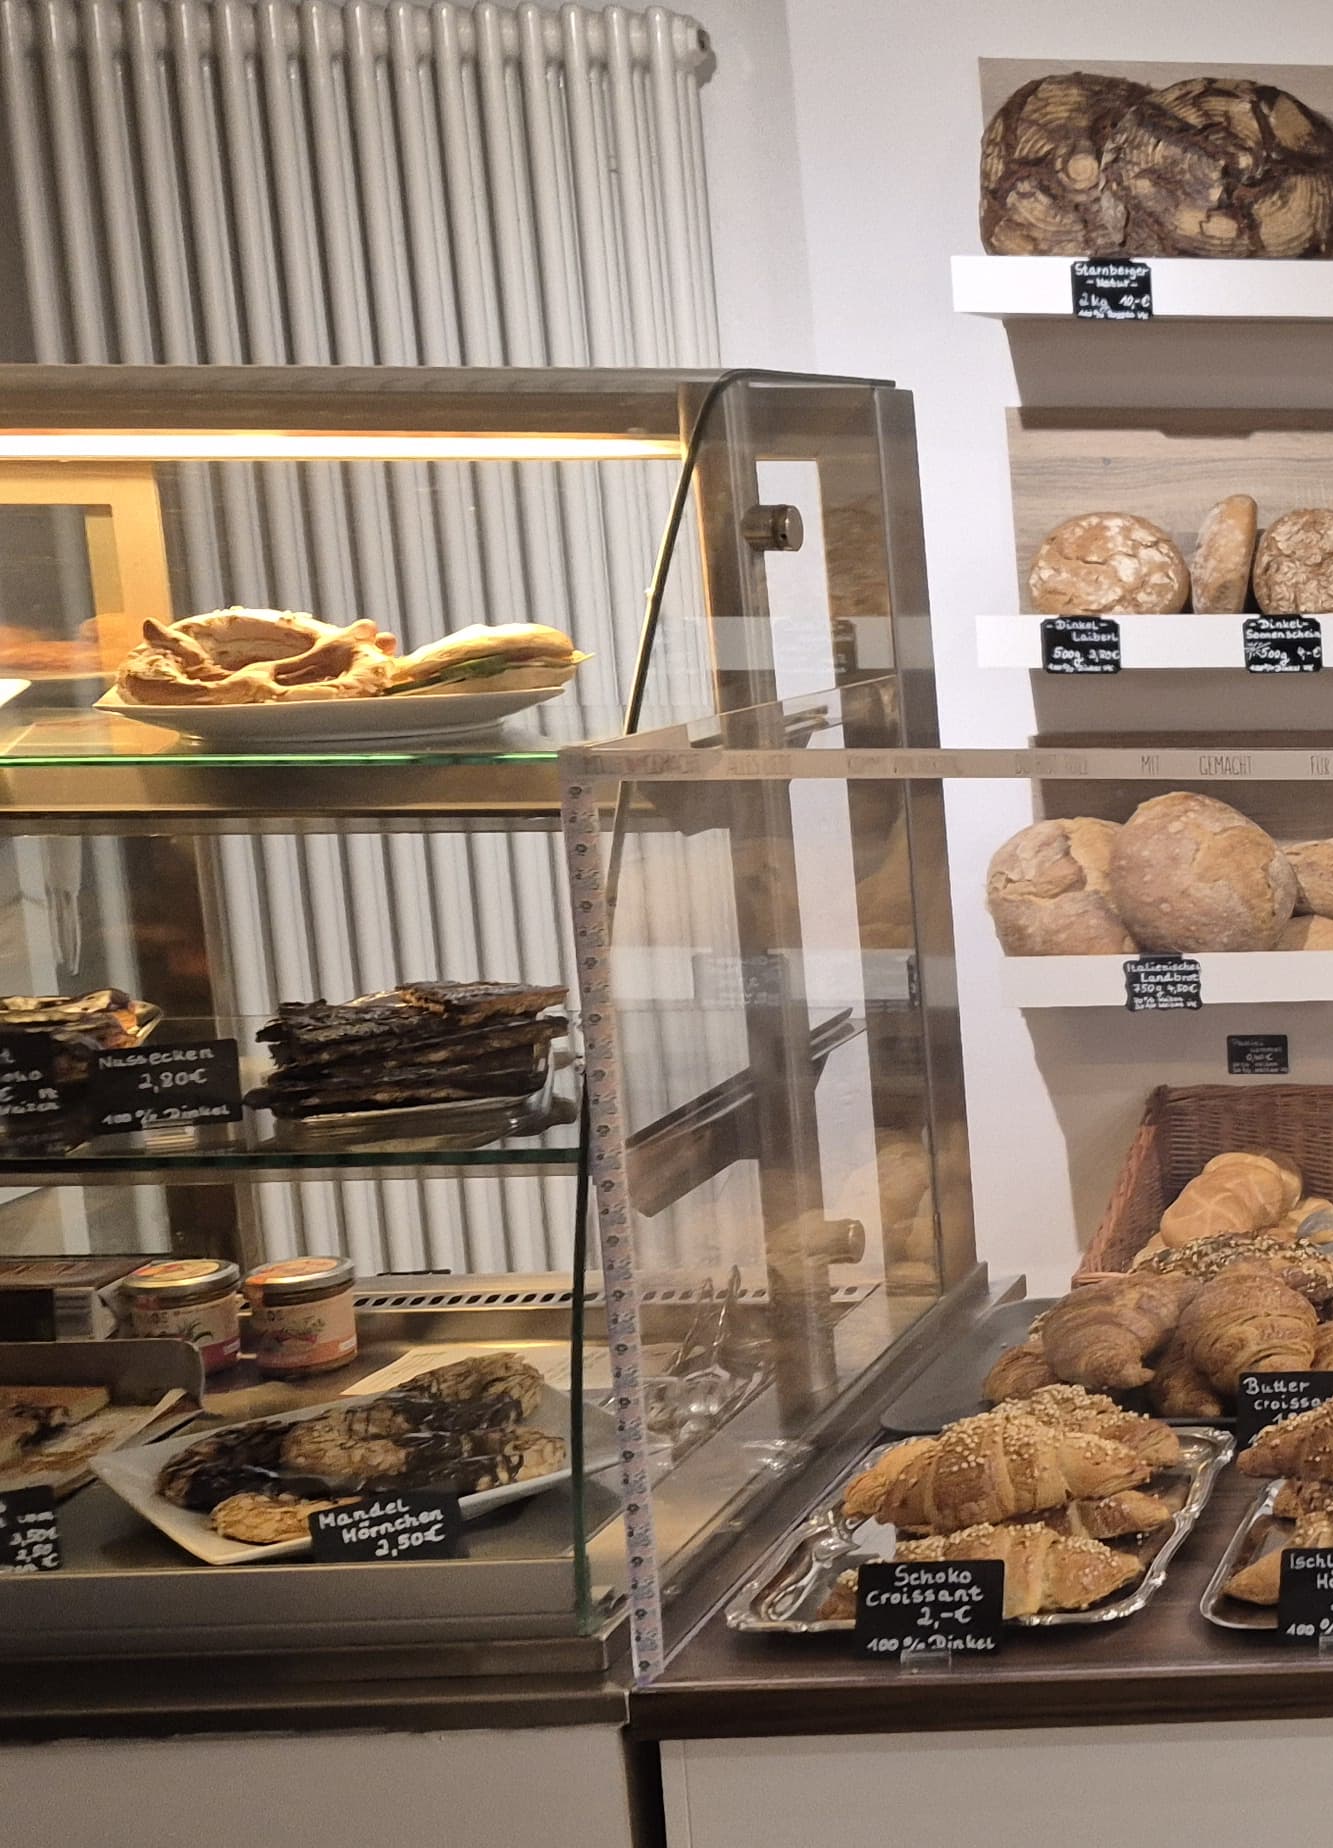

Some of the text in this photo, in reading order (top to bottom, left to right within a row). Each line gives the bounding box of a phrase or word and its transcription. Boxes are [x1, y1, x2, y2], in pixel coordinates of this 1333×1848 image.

[1074, 264, 1149, 280] Starnberger
[99, 1047, 215, 1069] Nussecken
[168, 1105, 231, 1122] Dinkel
[1242, 1377, 1310, 1395] Butter
[319, 1498, 410, 1529] Mandel
[342, 1509, 444, 1543] Hörnchen
[895, 1564, 972, 1587] Schoko
[865, 1584, 984, 1607] Croissant
[927, 1634, 996, 1651] Dinkel
